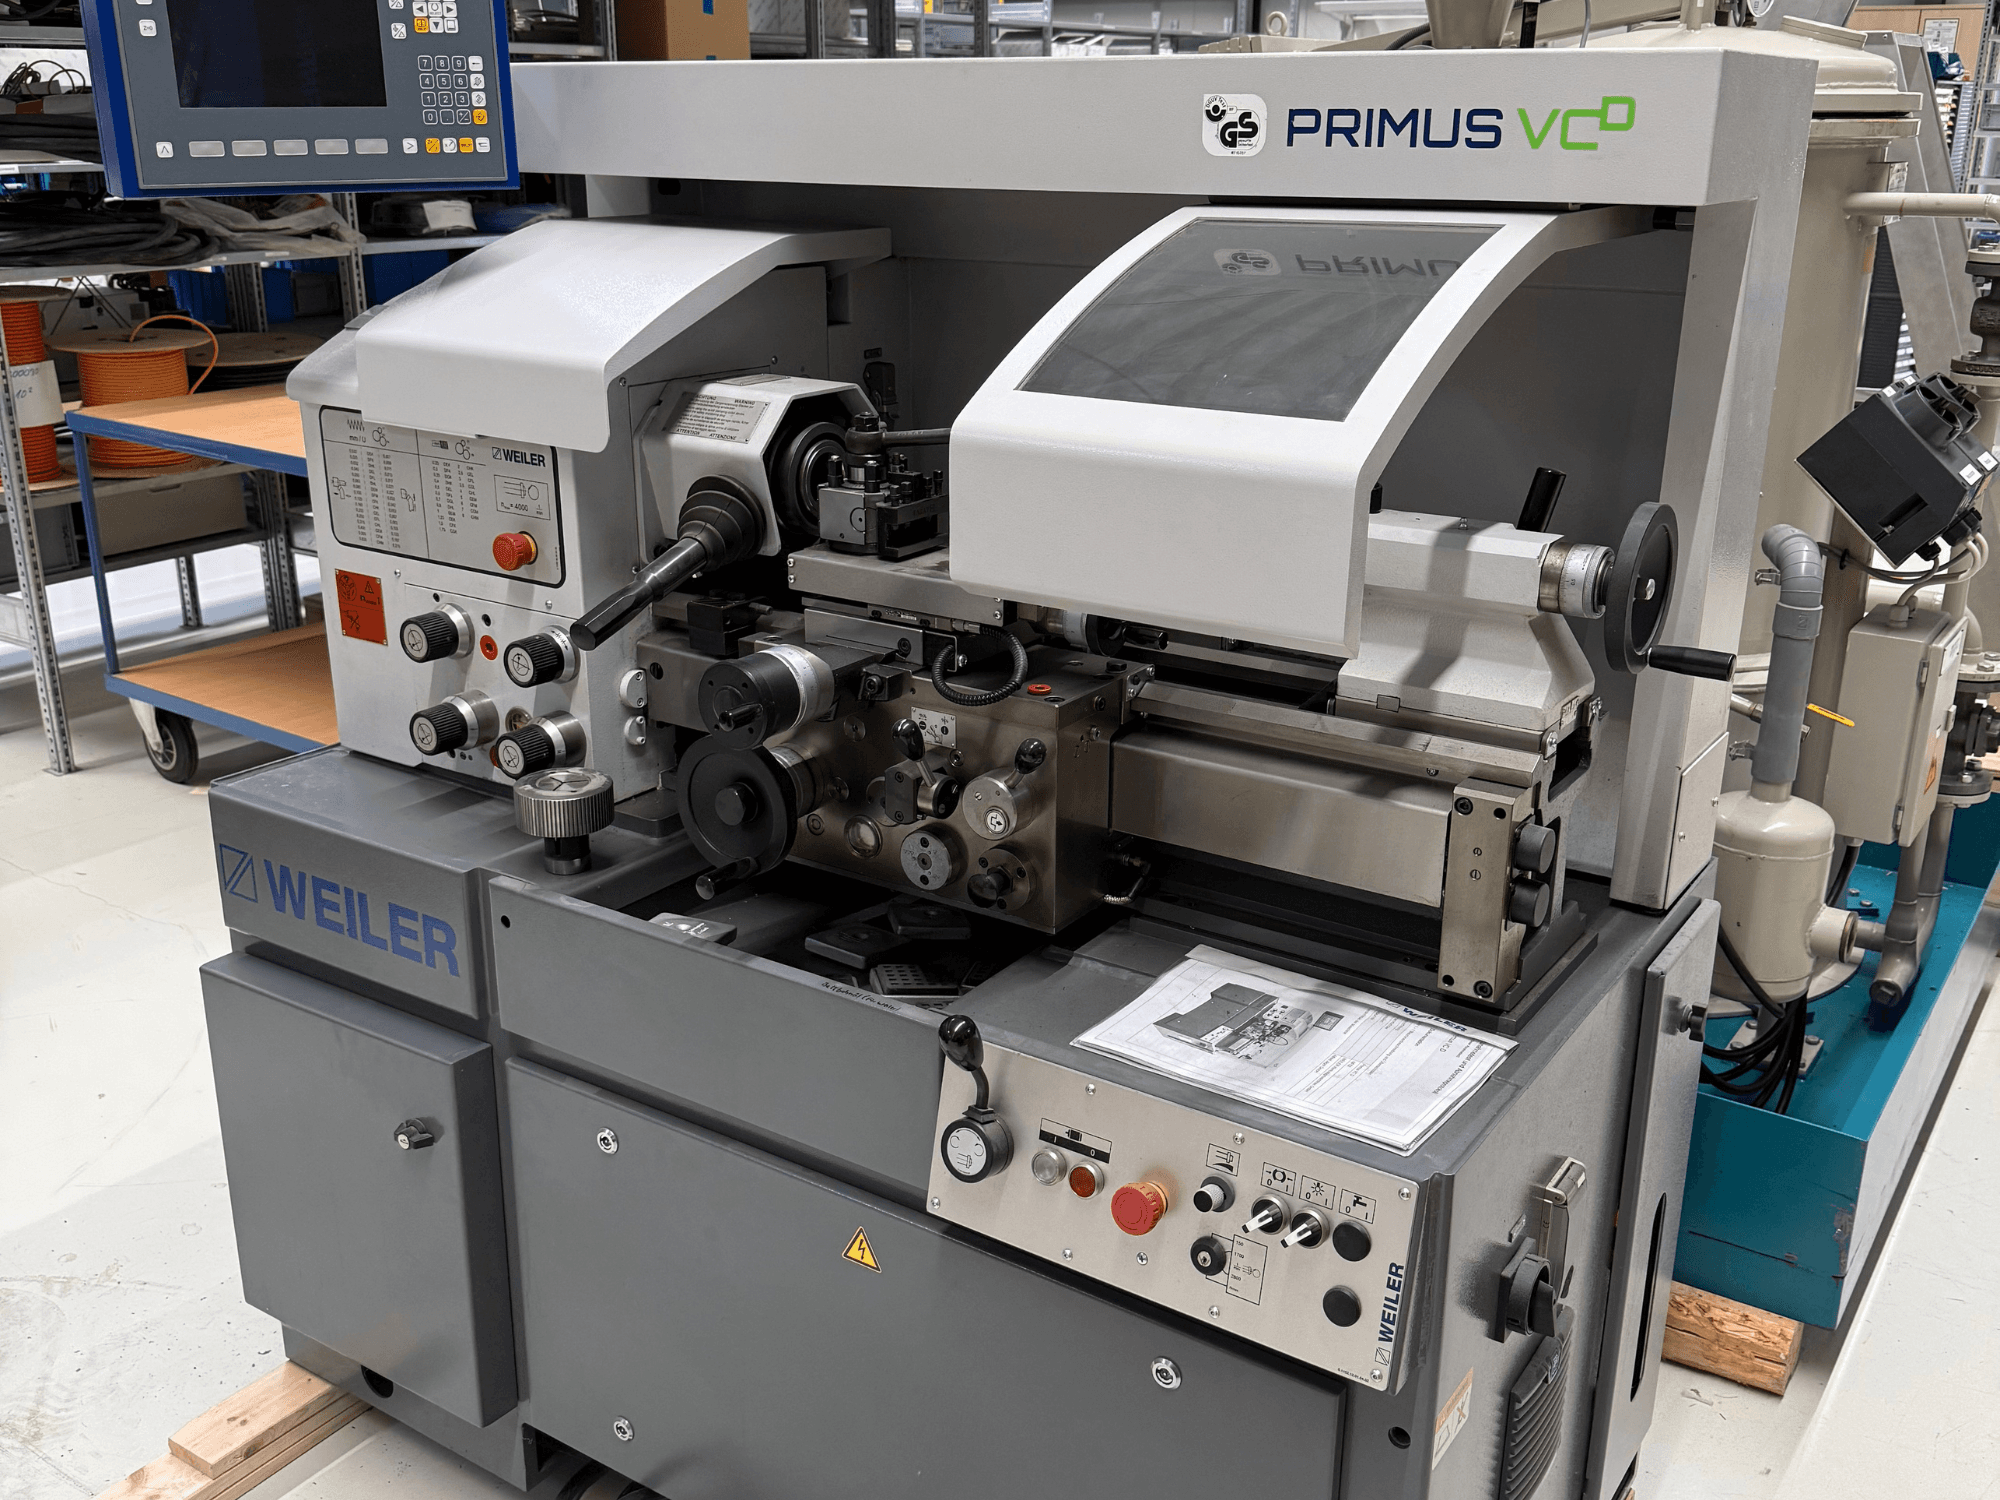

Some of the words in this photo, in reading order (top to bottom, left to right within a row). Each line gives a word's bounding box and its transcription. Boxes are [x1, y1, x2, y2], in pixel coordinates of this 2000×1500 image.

[428, 113, 433, 121] 0
[1220, 112, 1258, 148] GS
[1286, 108, 1504, 149] PRIMUS
[502, 448, 546, 468] WEILER
[514, 503, 528, 512] 4000
[264, 858, 460, 978] WEILER
[1266, 1178, 1272, 1186] 0
[1305, 1192, 1311, 1200] 0
[1378, 1262, 1404, 1343] WEILER
